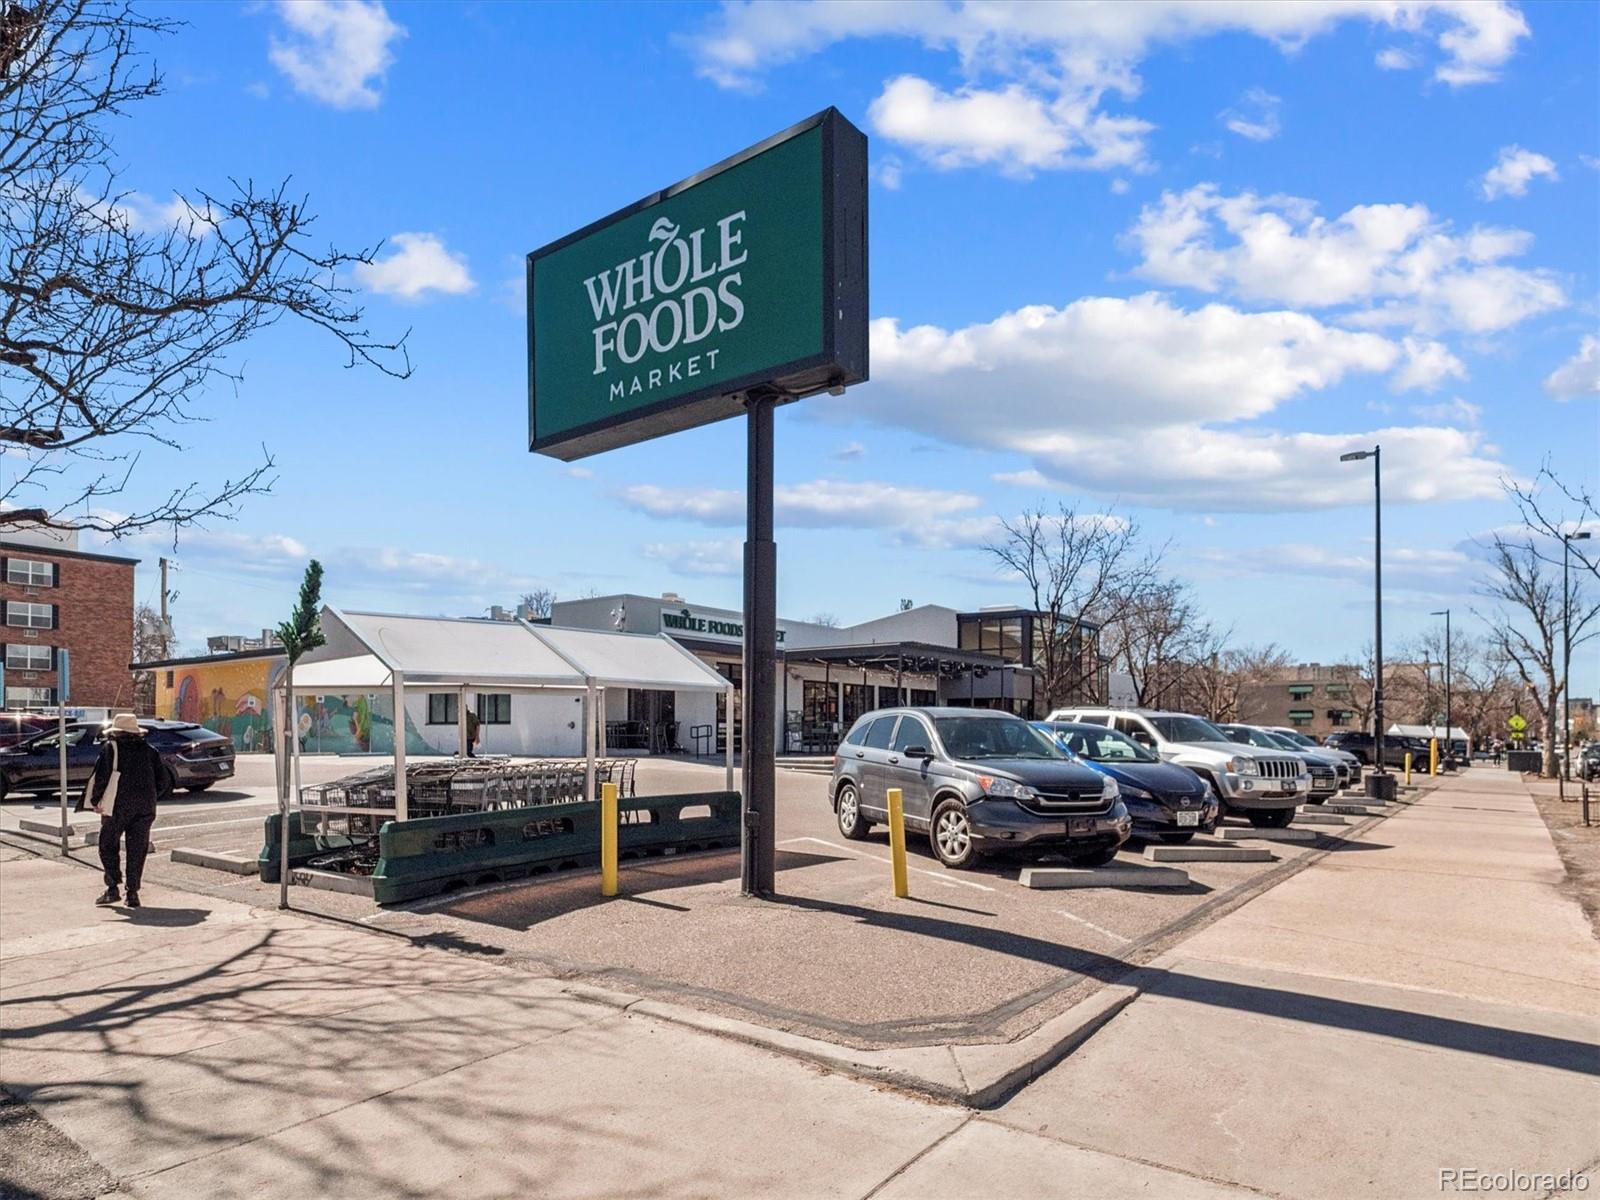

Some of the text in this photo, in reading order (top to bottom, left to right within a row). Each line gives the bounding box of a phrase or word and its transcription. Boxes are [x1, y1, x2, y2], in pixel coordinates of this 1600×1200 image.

[584, 210, 747, 321] WHOLE
[592, 272, 744, 375] FOODS
[609, 349, 719, 401] MARKET
[663, 612, 743, 637] WHOLE FOODS
